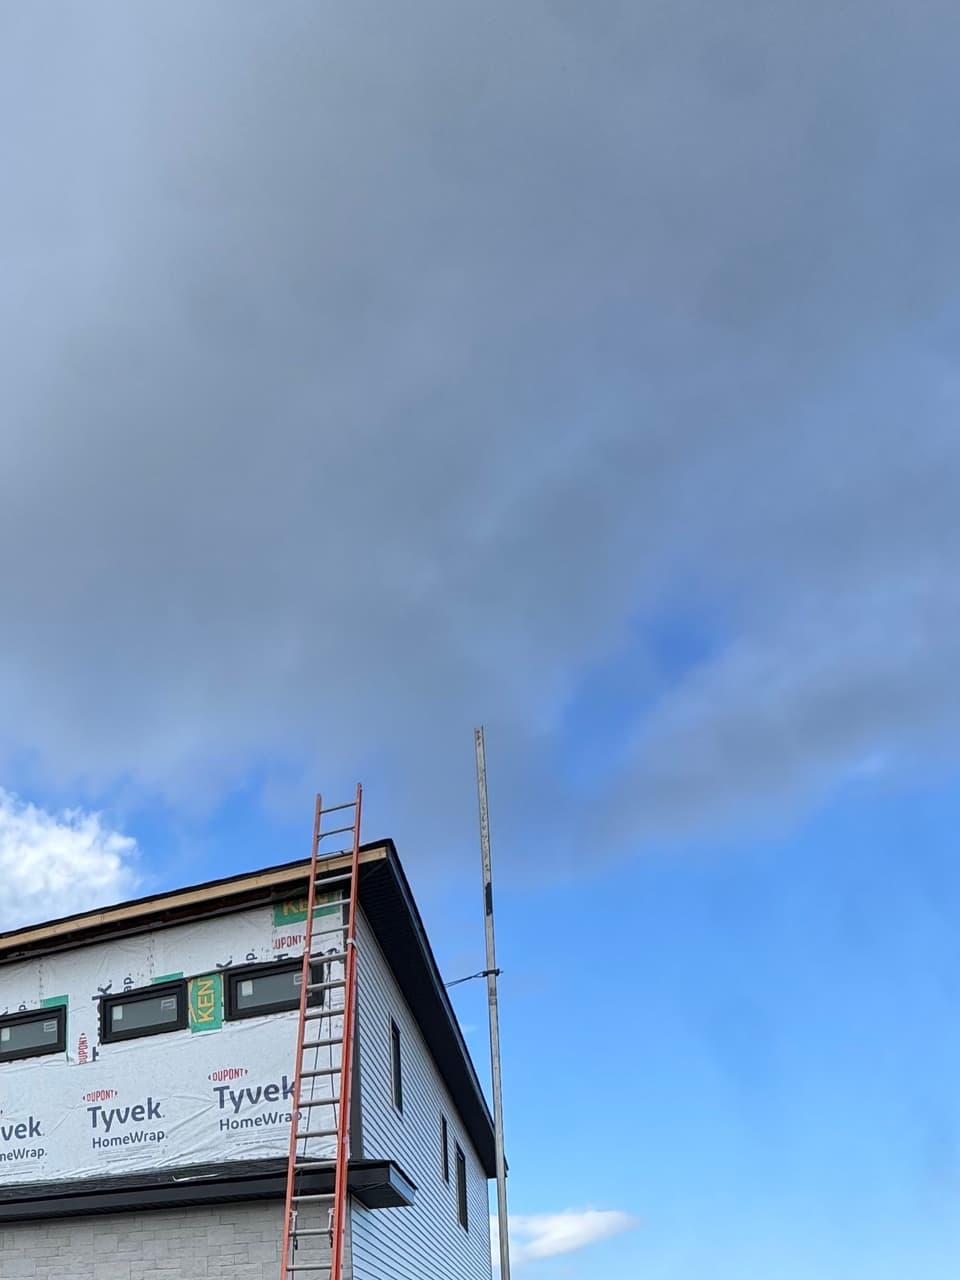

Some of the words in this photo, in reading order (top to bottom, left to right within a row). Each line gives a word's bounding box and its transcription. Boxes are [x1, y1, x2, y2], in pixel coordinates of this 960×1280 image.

[273, 935, 302, 949] UPONT
[212, 1068, 244, 1081] DUPONT
[86, 1090, 114, 1102] DUPONT
[213, 1075, 295, 1114] Tyvek
[87, 1097, 161, 1133] Tyvek
[92, 1131, 165, 1149] HomeWrap
